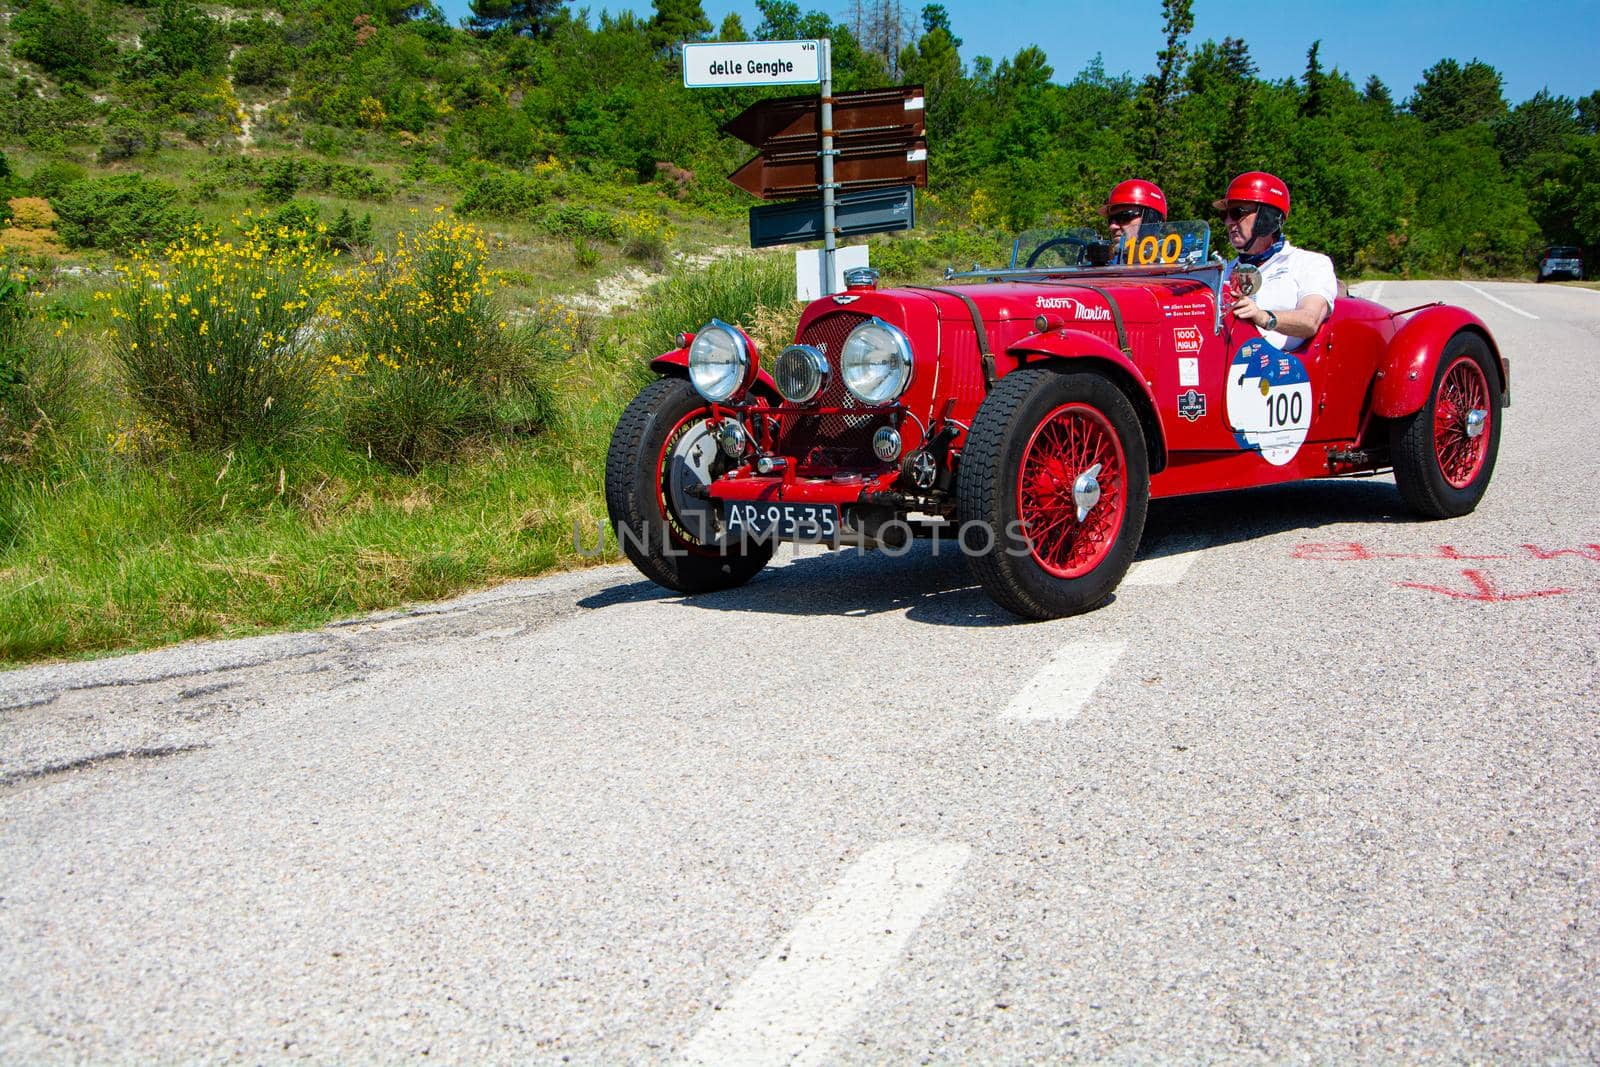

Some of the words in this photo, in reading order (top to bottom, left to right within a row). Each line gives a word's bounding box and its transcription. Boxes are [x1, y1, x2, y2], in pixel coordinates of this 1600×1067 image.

[802, 43, 815, 51] via
[709, 60, 742, 76] delle
[747, 59, 793, 76] Genghe
[1124, 233, 1182, 265] 100
[1036, 296, 1071, 309] Aston
[1074, 302, 1111, 321] Martin
[1177, 331, 1196, 339] 1000
[1177, 341, 1198, 349] MIGLIA
[1266, 391, 1303, 428] 100
